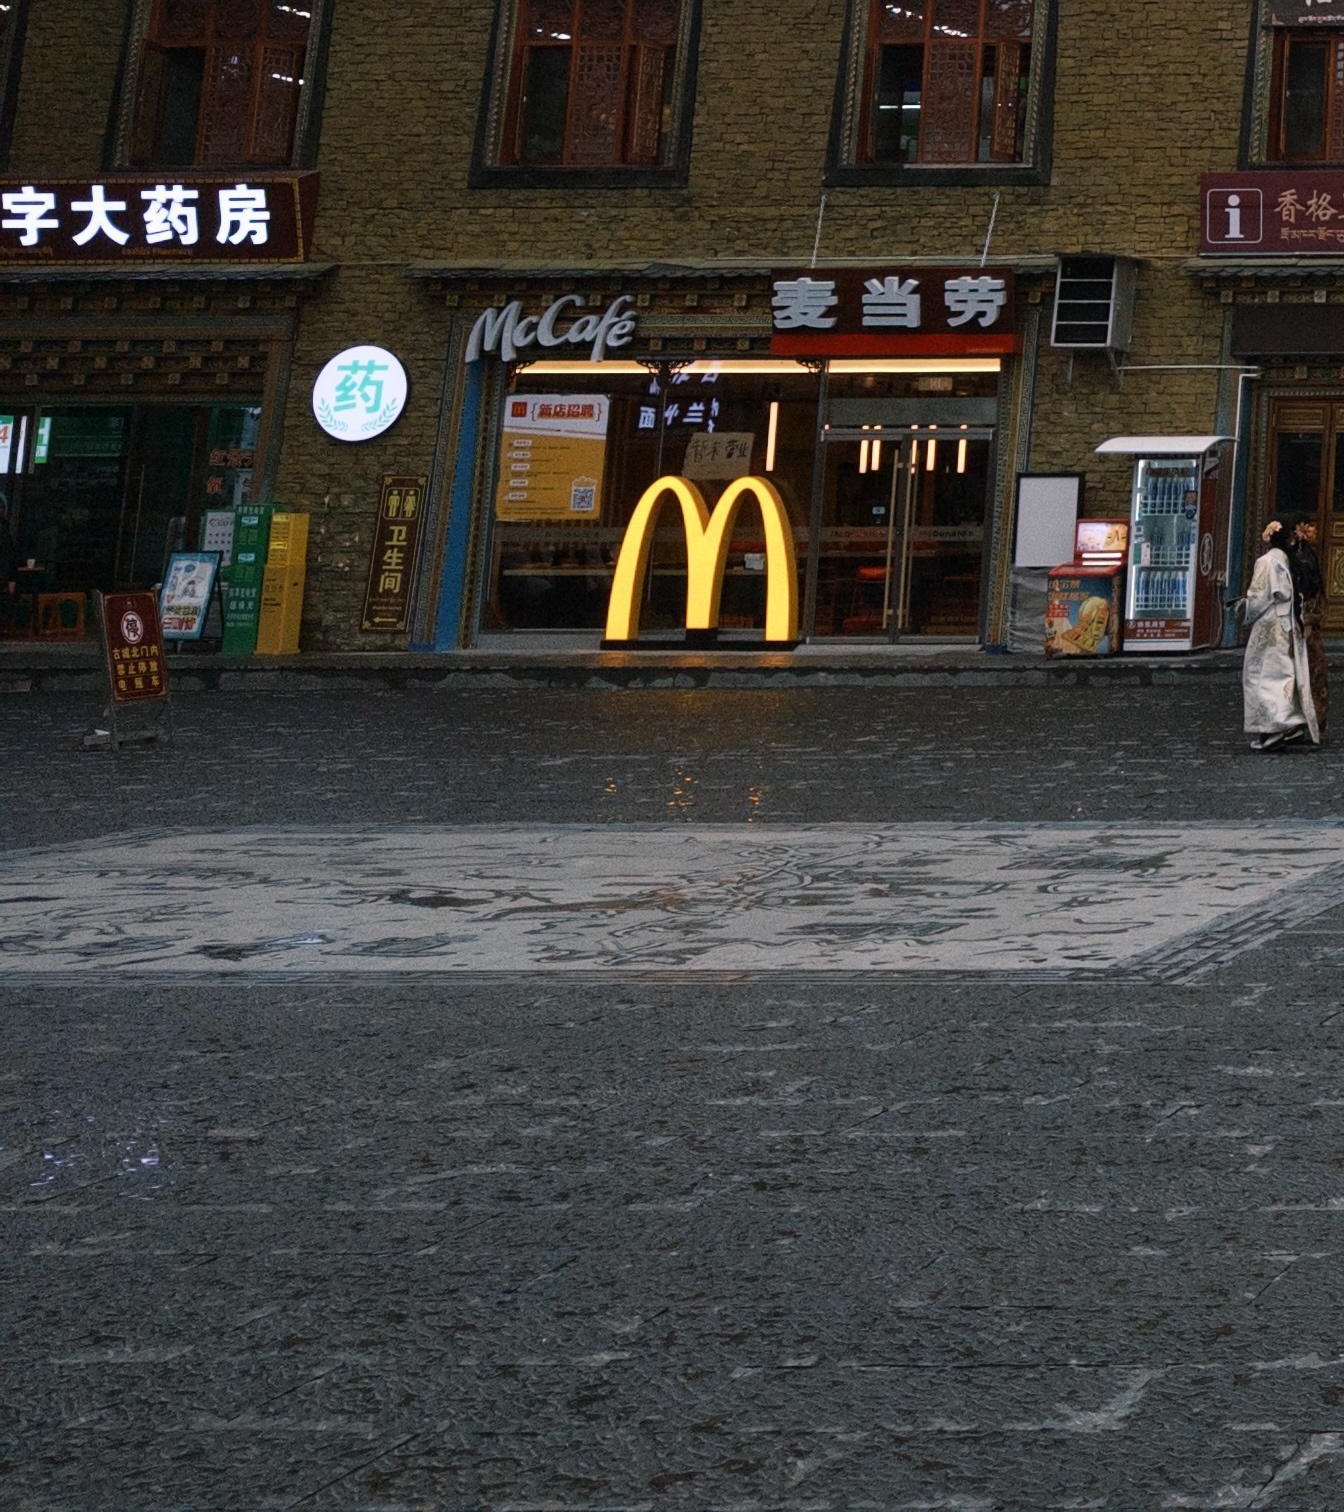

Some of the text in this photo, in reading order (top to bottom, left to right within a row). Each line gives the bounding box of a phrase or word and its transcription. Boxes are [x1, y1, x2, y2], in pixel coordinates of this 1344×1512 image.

[1, 184, 271, 246] 字大药房
[464, 294, 639, 363] McCafé
[771, 276, 1007, 329] 麦当劳
[334, 360, 389, 414] 药
[538, 403, 594, 418] 新店招聘
[379, 525, 408, 593] 卫生间
